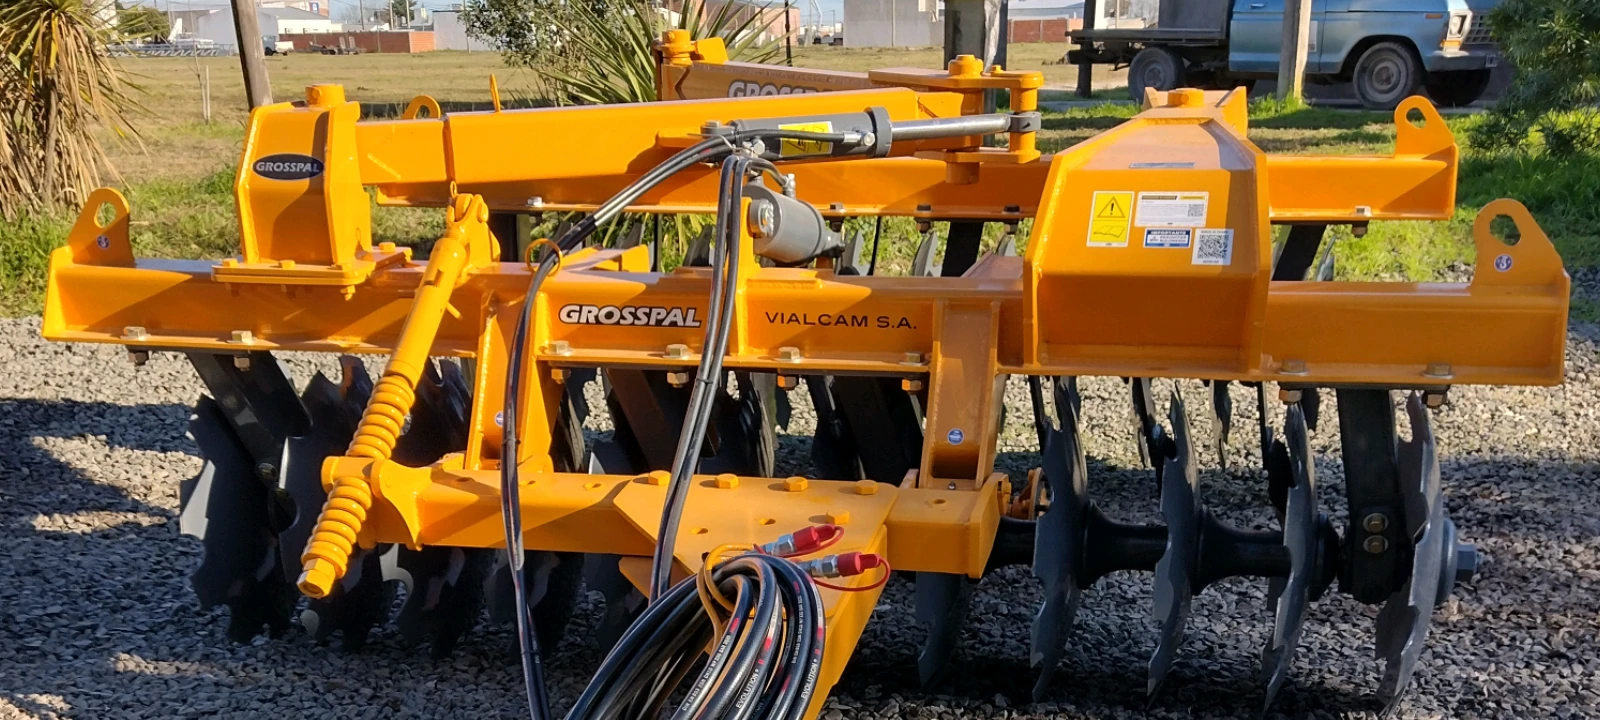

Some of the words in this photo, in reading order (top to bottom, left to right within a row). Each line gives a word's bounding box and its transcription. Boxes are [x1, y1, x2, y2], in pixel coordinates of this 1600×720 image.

[256, 162, 320, 172] GROSSPAL
[558, 304, 701, 328] GROSSPAL
[765, 312, 868, 327] VIALCAM
[876, 316, 918, 329] S.A.
[735, 673, 759, 708] EVOLUTION
[801, 662, 818, 699] EVOLUTION
